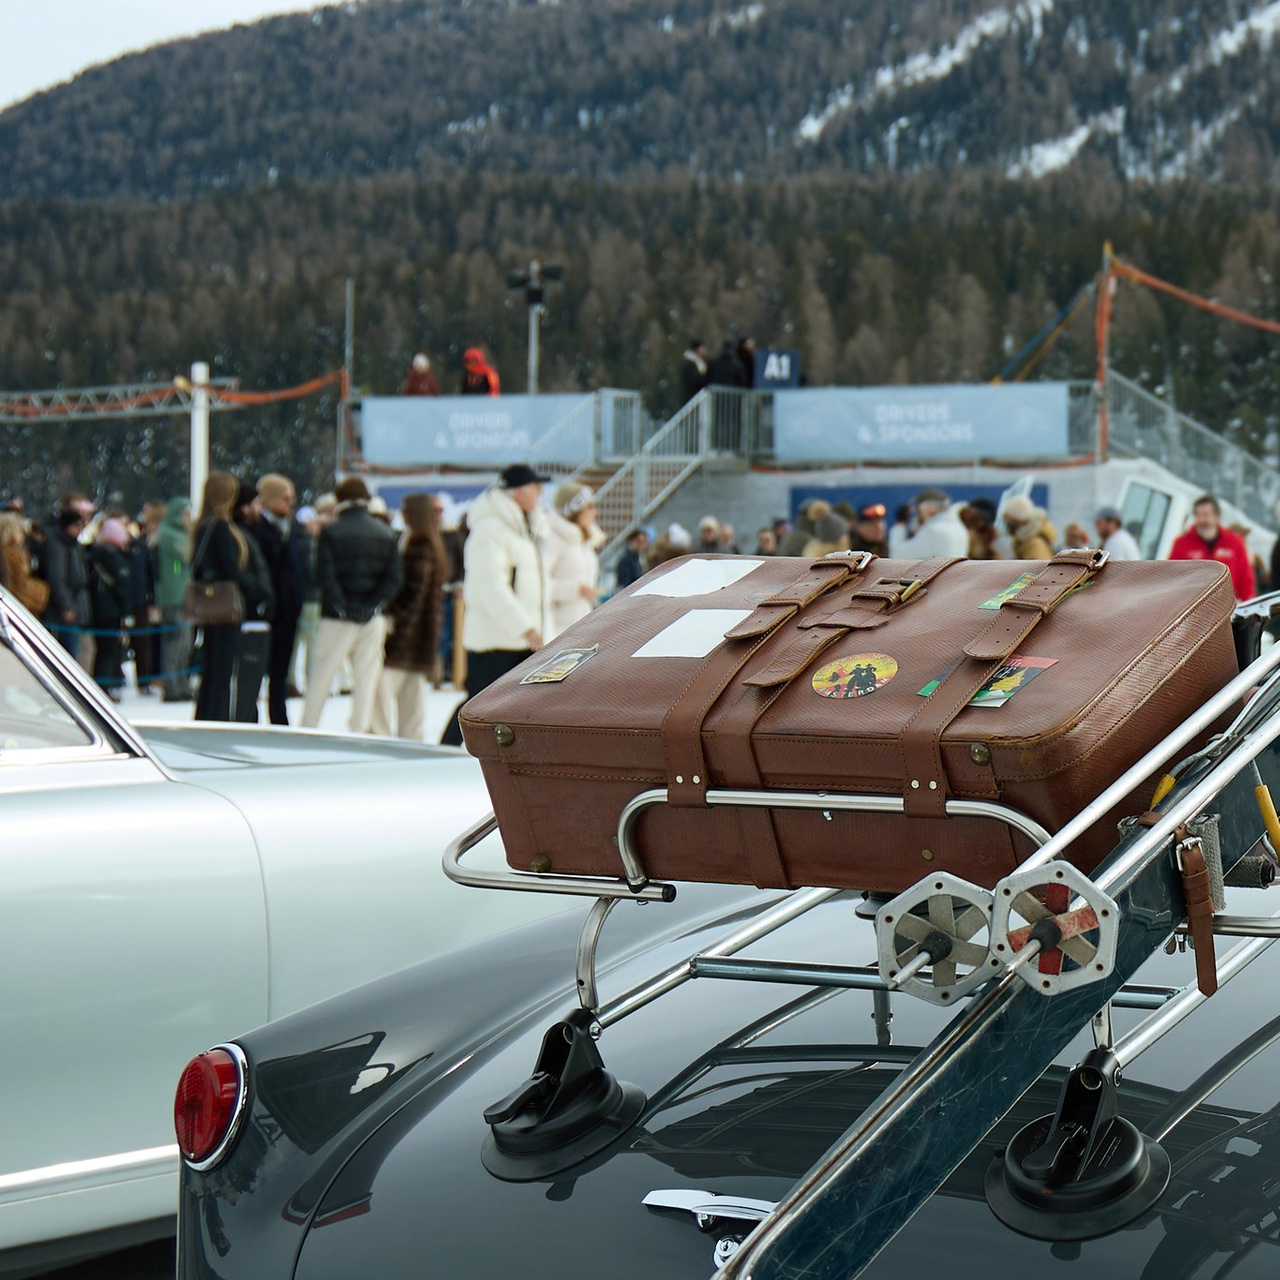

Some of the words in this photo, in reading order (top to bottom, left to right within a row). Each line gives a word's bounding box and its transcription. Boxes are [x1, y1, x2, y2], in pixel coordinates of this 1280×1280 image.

[764, 352, 791, 381] A1
[875, 404, 950, 422] DRIVERS
[879, 422, 973, 443] SPONSORS
